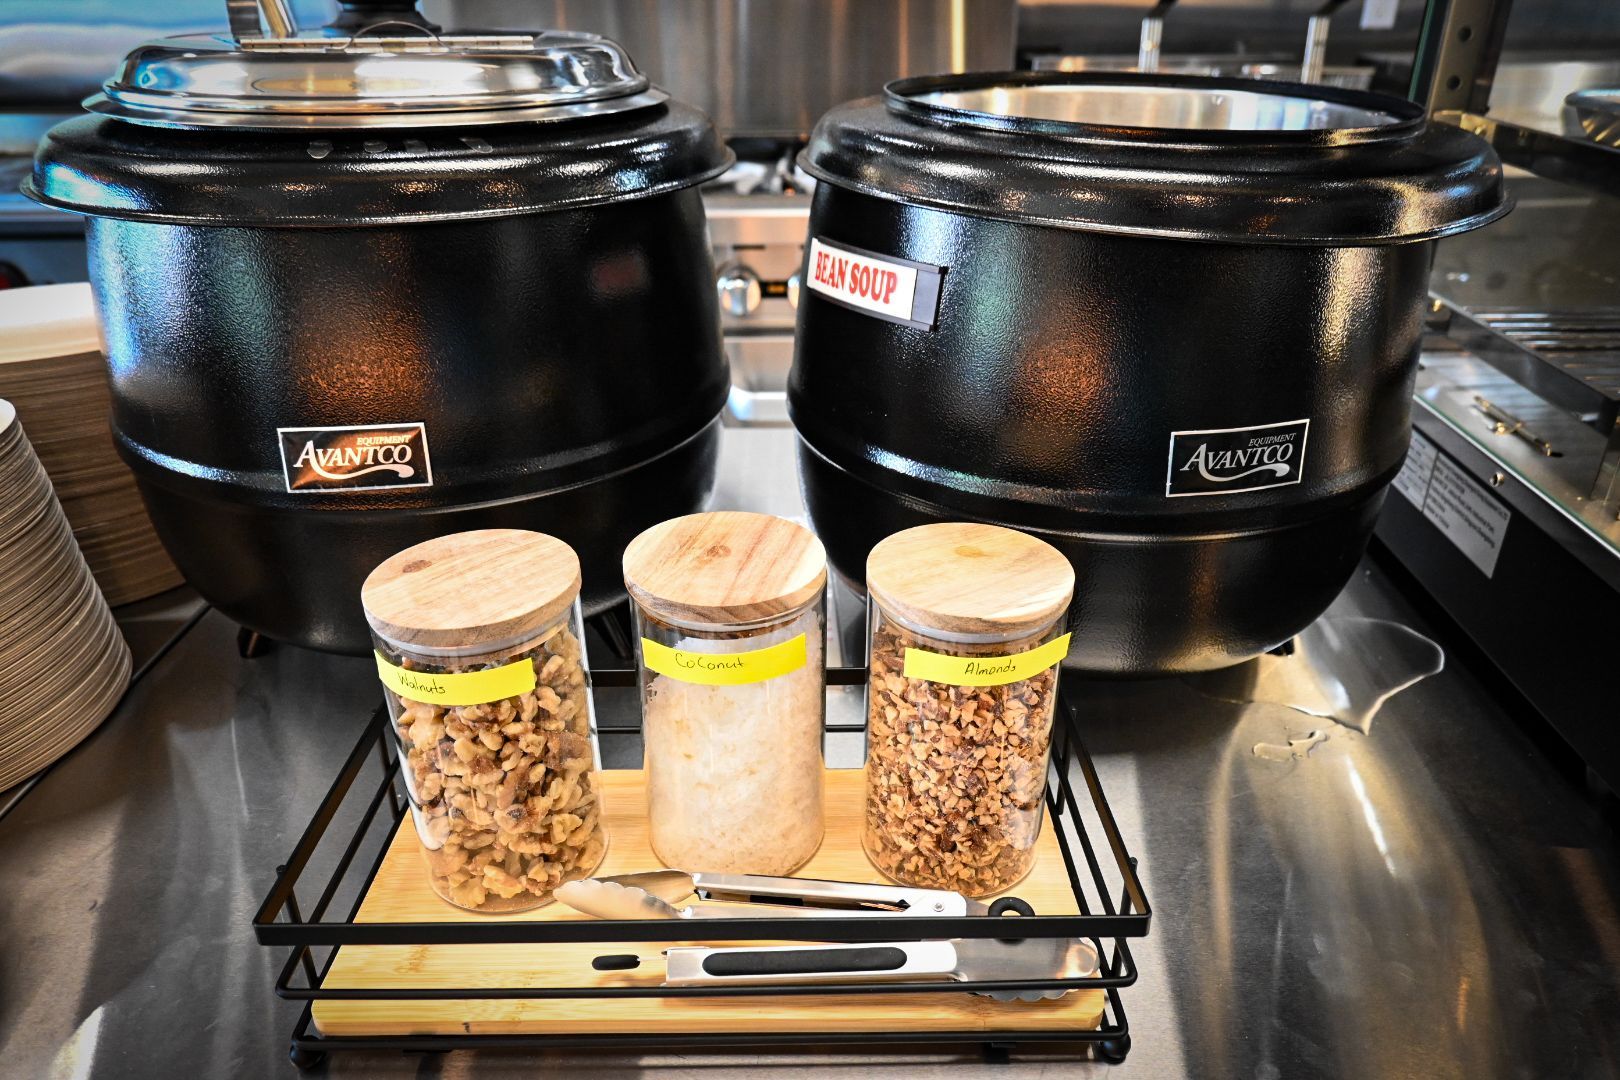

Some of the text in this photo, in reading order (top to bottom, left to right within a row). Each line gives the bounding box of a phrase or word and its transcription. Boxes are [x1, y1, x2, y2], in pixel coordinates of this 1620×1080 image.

[815, 251, 898, 304] BEAN SOUP
[356, 434, 412, 446] EQUIPMENT
[1248, 432, 1297, 447] EQUIPMENT
[293, 439, 415, 480] AVANTCO
[1179, 442, 1294, 482] AVANTCO
[964, 659, 1017, 676] Almonds
[397, 672, 447, 695] Walnuts
